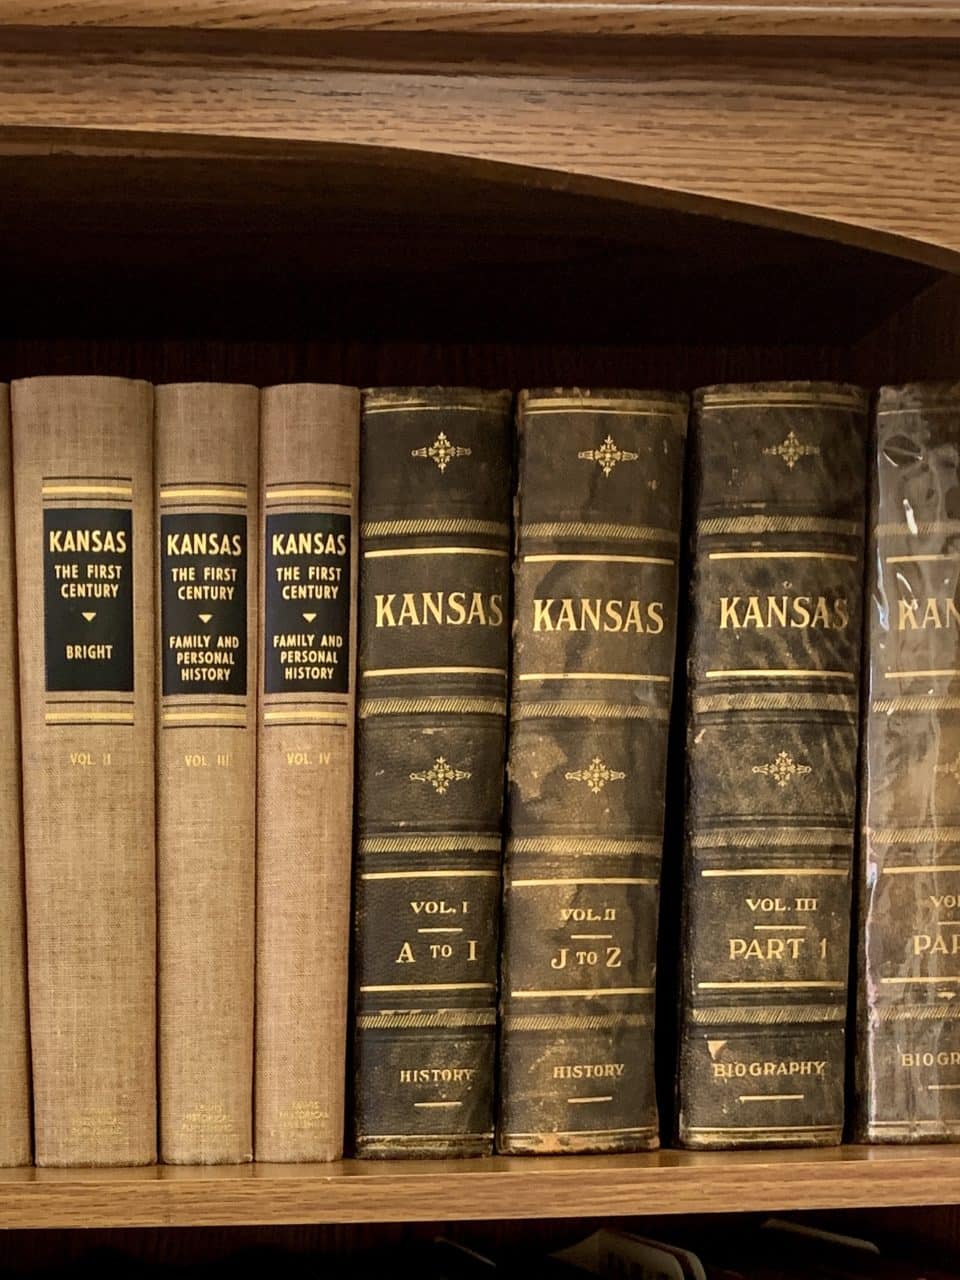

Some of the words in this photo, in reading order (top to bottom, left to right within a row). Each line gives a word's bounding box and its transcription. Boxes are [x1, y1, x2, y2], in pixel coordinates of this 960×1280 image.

[168, 533, 241, 555] KANSAS
[172, 567, 195, 581] THE
[204, 567, 236, 581] FIRST
[178, 586, 233, 600] CENTURY
[375, 592, 501, 627] KANSAS
[533, 599, 663, 633] KANSAS
[720, 596, 848, 629] KANSAS
[170, 636, 210, 648] FAMILY
[217, 636, 239, 648] AND
[177, 652, 234, 664] PERSONAL
[182, 668, 230, 680] HISTORY
[411, 901, 455, 914] VOL.
[463, 902, 469, 913] I
[397, 942, 416, 963] A
[431, 945, 452, 958] TO
[467, 941, 477, 961] I
[729, 940, 805, 960] PART
[818, 940, 826, 959] 1
[400, 1069, 473, 1082] HISTORY
[713, 1062, 826, 1077] BIOGRAPHY
